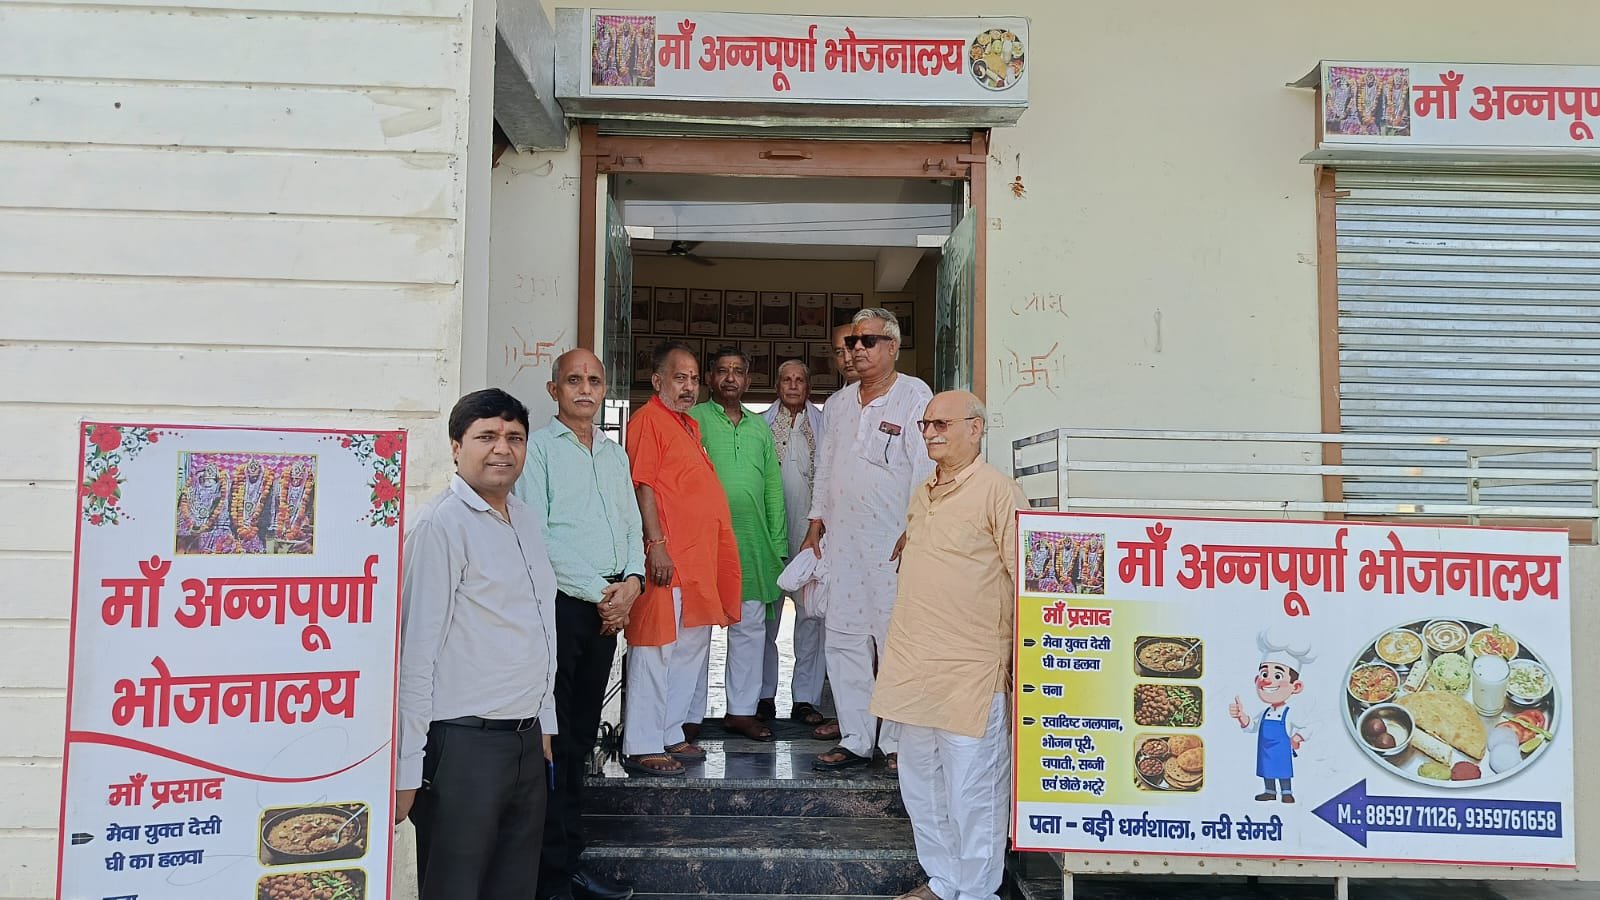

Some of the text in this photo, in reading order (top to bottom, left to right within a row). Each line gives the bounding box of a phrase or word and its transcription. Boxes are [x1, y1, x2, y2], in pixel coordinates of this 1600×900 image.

[658, 19, 965, 92] माँ अन्नपूर्णा भोजनालय
[1413, 71, 1464, 119] माँ
[1116, 520, 1563, 618] माँ अन्नपूर्णा भोजनालय
[101, 554, 379, 652] माँ अन्नपूर्णा
[1043, 601, 1111, 627] माँ प्रसाद
[1042, 634, 1111, 653] मेवा युक्त देसी
[1042, 654, 1101, 670] घी का हलवा
[111, 656, 361, 728] भोजनालय
[1042, 685, 1063, 697] चना
[1042, 713, 1123, 732] स्वादिष्ट जलपान,
[1042, 734, 1095, 754] भोजन पूरी,
[1042, 755, 1105, 771] चपाती, सब्जी
[109, 773, 224, 808] माँ प्रसाद
[1041, 775, 1105, 796] एवं छोले भटूरे
[106, 814, 223, 845] मेवा युक्त देसी
[1028, 814, 1063, 834] पता
[1081, 809, 1115, 843] बड़ी
[1118, 810, 1196, 841] धर्मशाला,
[1201, 813, 1233, 840] नरी
[1235, 814, 1284, 842] सेमरी
[1366, 804, 1413, 826] 88597
[1415, 806, 1462, 831] 71126,
[1465, 807, 1556, 831] 9359761658
[104, 849, 205, 872] घी का हलवा
